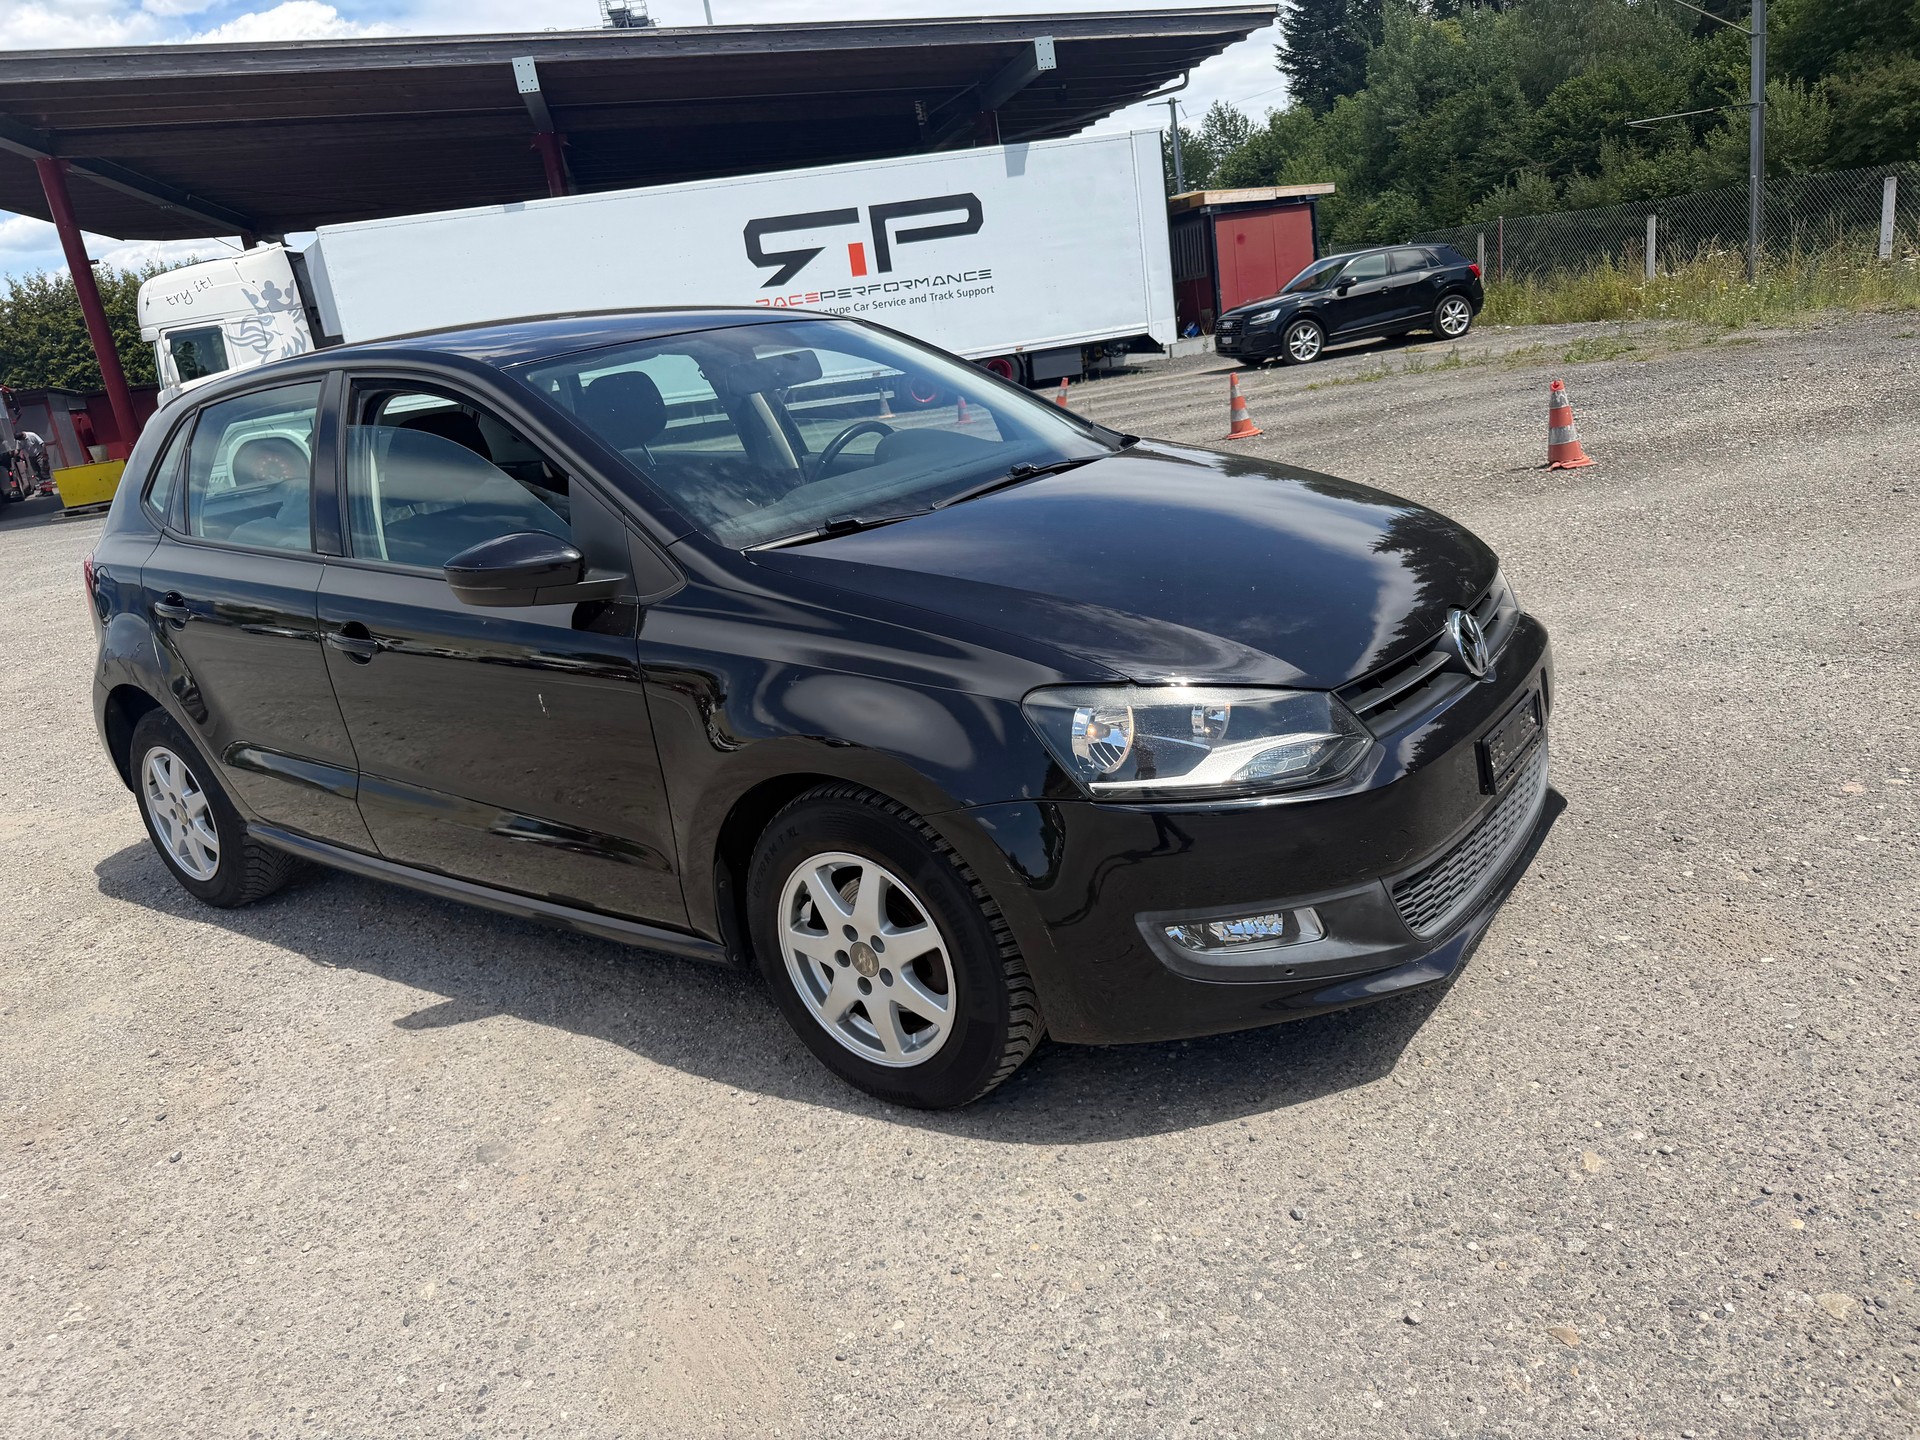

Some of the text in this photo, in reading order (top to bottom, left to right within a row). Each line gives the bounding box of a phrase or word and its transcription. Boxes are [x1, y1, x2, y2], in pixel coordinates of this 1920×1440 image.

[165, 277, 213, 305] try it!
[853, 302, 870, 312] Car
[872, 298, 907, 309] Service
[909, 294, 927, 305] and
[929, 290, 954, 302] Track
[957, 285, 995, 299] Support
